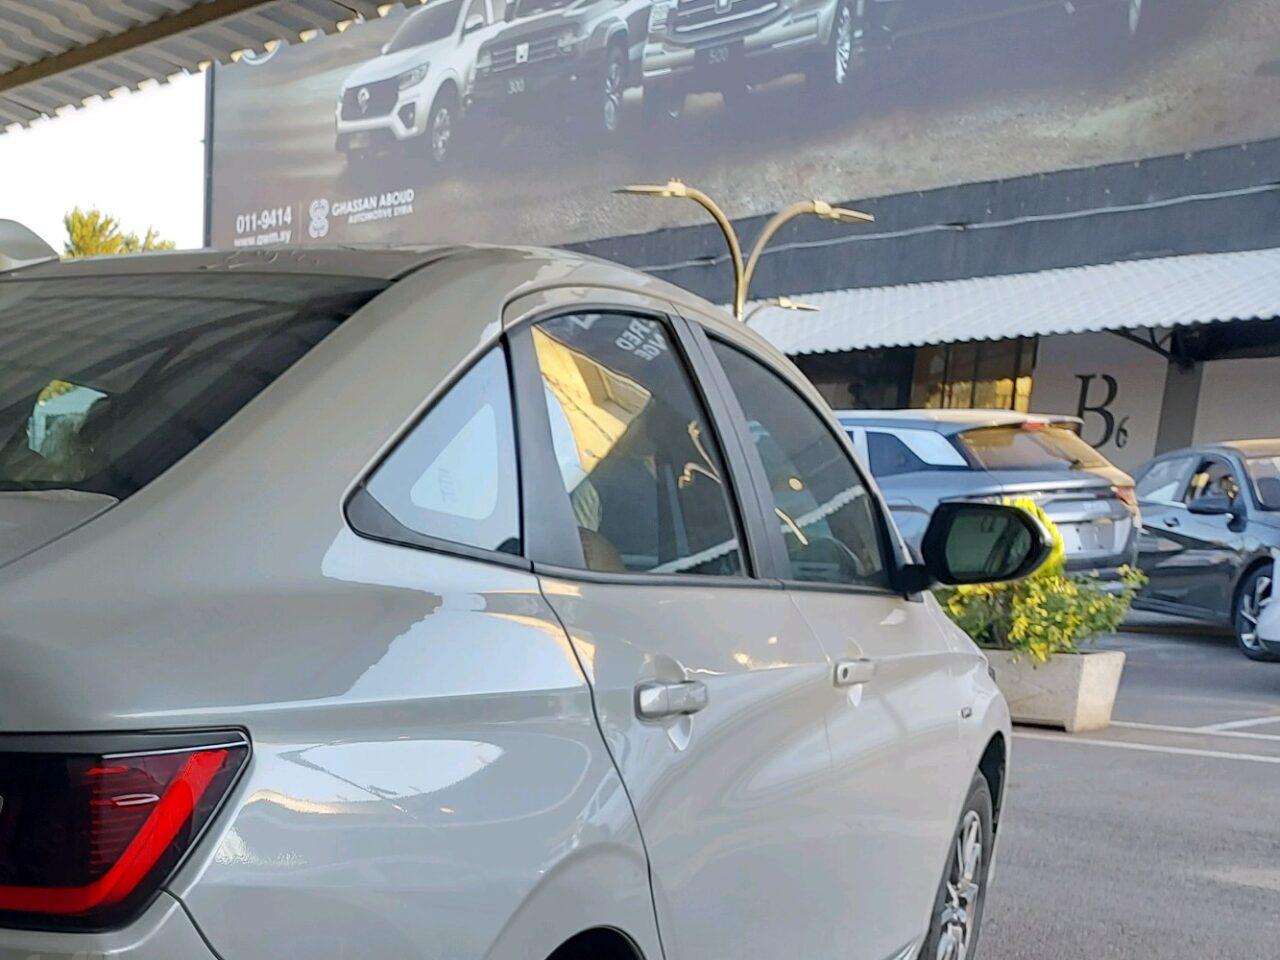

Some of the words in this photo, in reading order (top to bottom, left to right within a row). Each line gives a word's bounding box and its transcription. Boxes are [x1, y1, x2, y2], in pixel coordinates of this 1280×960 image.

[331, 195, 378, 217] GHASSAN
[378, 189, 415, 209] ABOUD
[236, 205, 292, 234] 011-9414
